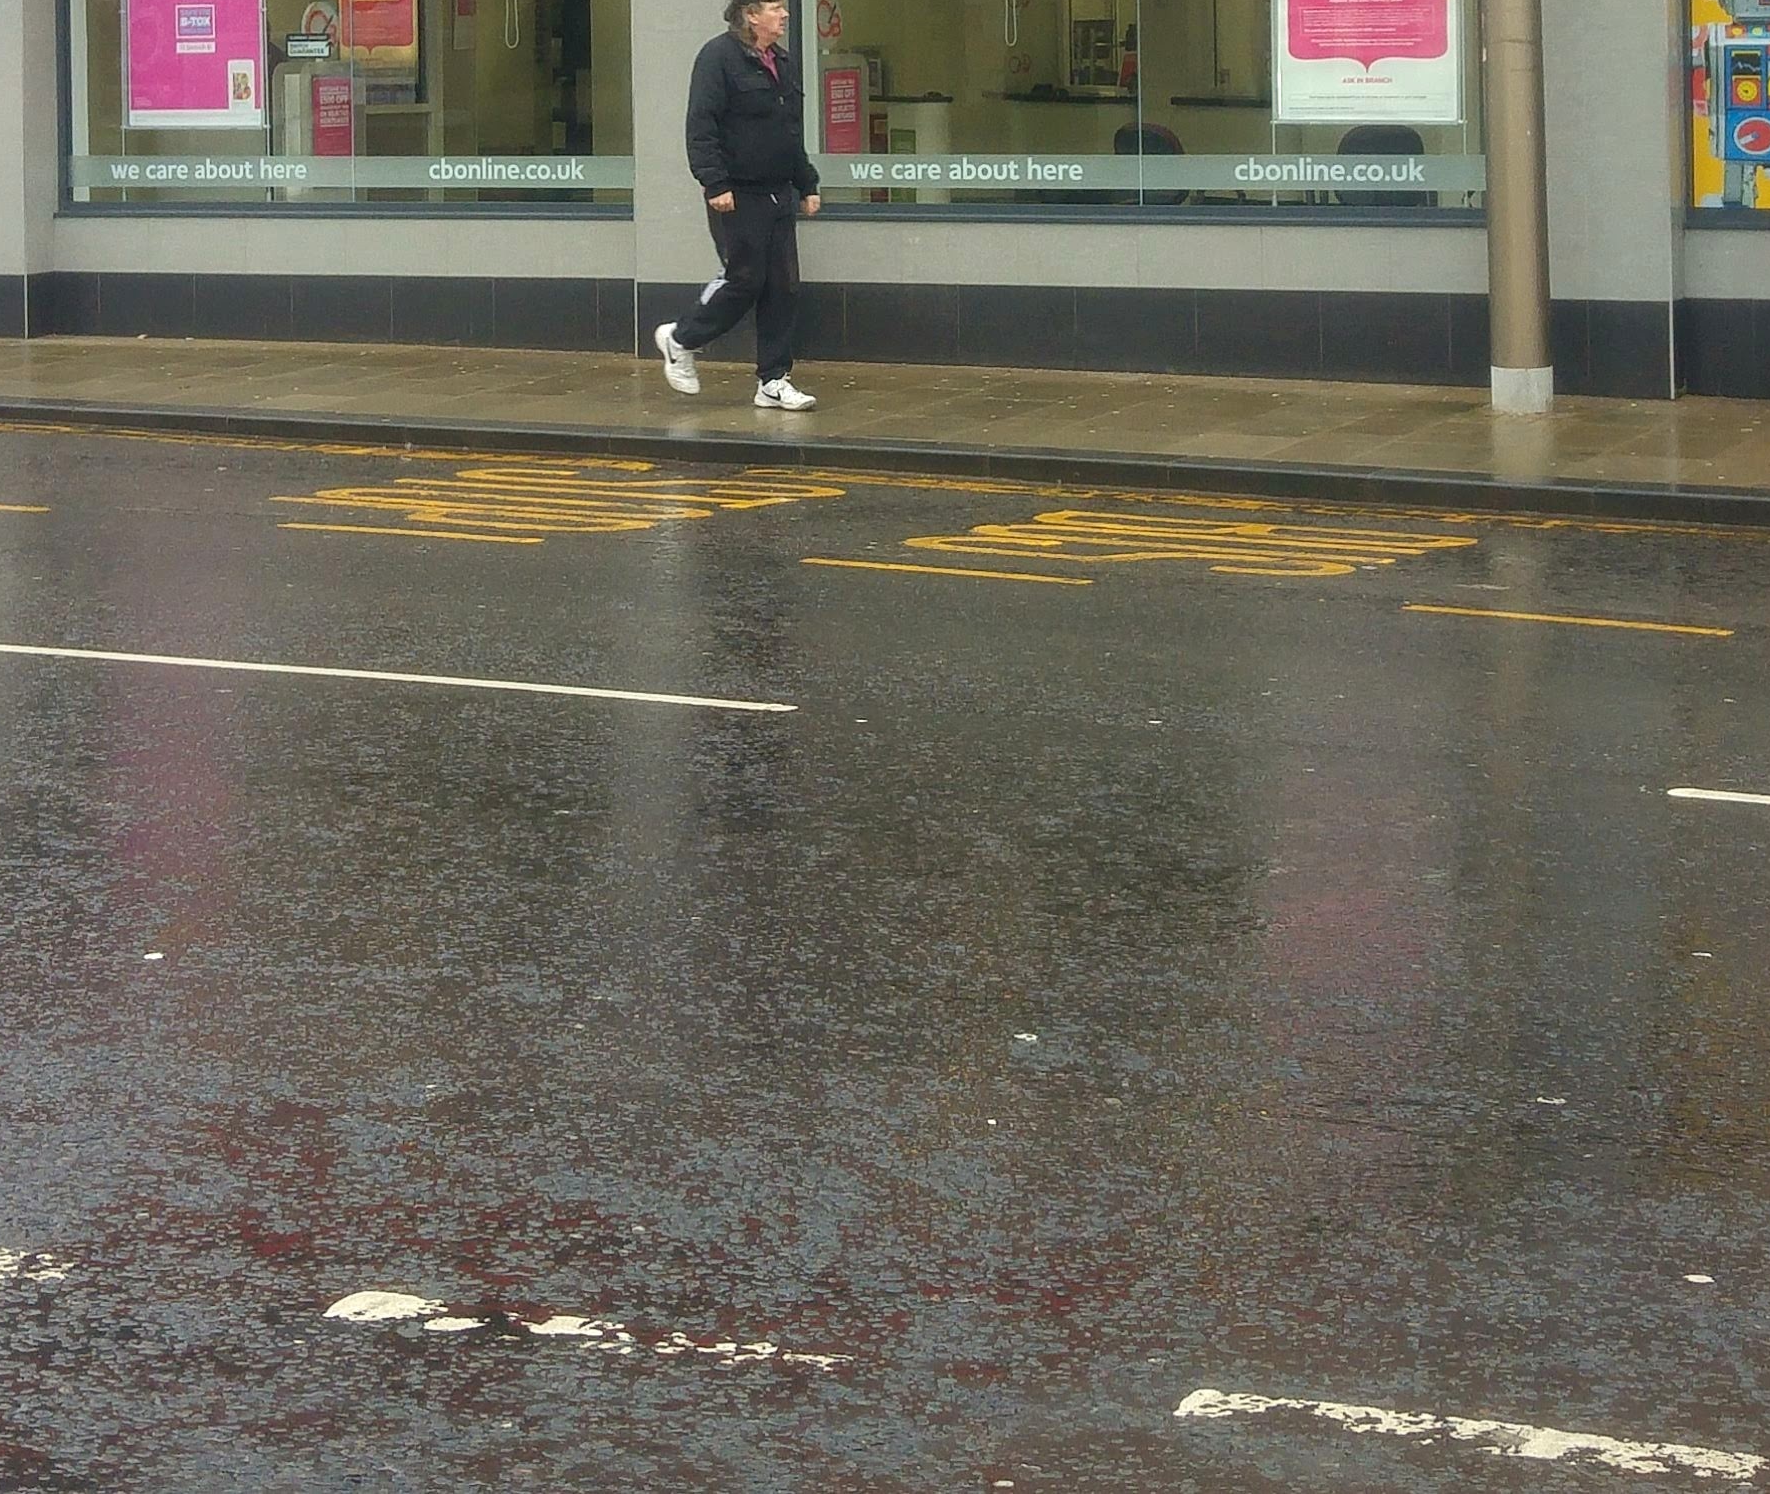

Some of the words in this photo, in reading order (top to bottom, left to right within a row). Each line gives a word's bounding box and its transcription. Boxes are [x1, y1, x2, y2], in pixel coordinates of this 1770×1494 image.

[111, 164, 143, 180] we
[145, 164, 190, 180] care
[194, 159, 254, 181] about
[259, 159, 307, 181] here
[429, 159, 584, 182] cbonline.co.uk
[850, 164, 886, 181] we
[891, 164, 943, 181] care
[949, 159, 1019, 182] about
[1027, 159, 1083, 182] here
[1234, 157, 1425, 183] cbonline.co.uk
